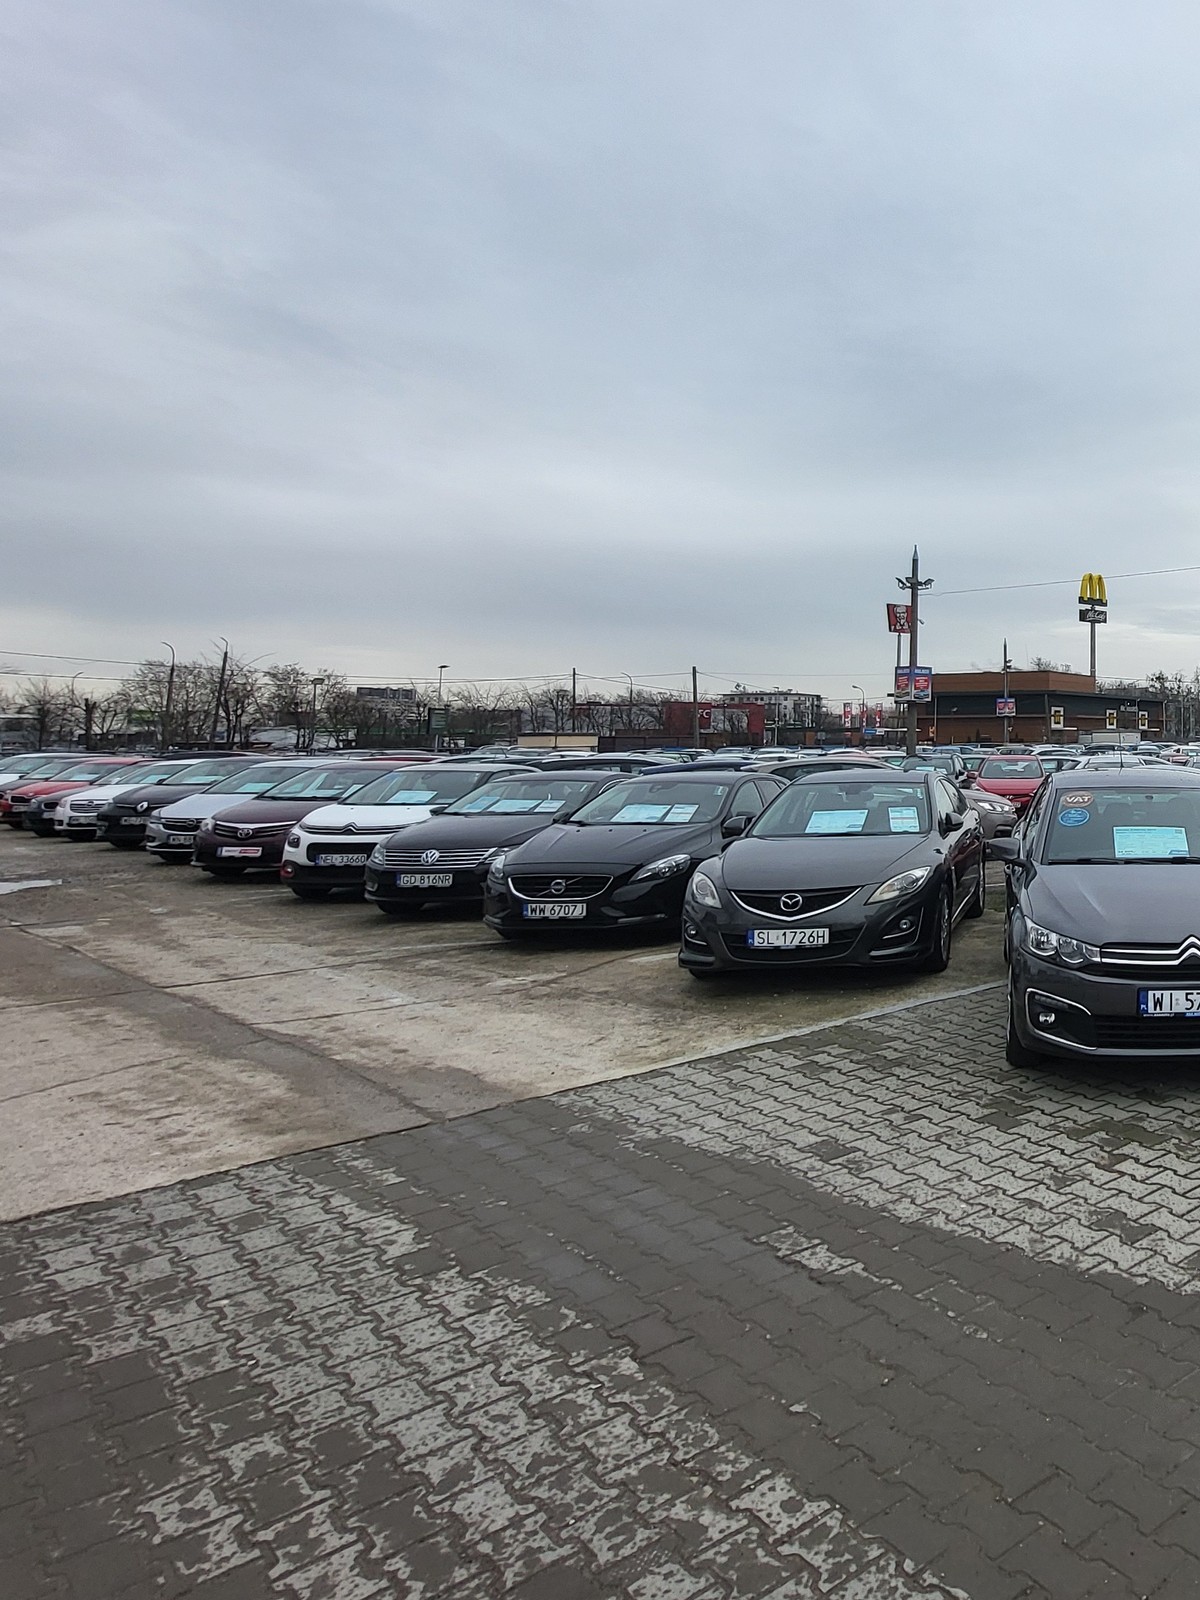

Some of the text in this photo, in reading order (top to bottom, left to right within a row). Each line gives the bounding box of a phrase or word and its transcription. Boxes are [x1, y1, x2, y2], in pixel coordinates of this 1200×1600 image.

[697, 709, 711, 718] FC
[339, 855, 366, 864] 33660
[402, 874, 451, 885] GD 816NR
[529, 904, 585, 916] WW 6707J
[757, 931, 775, 945] SL
[781, 930, 826, 945] 1726H
[1153, 992, 1173, 1011] WI
